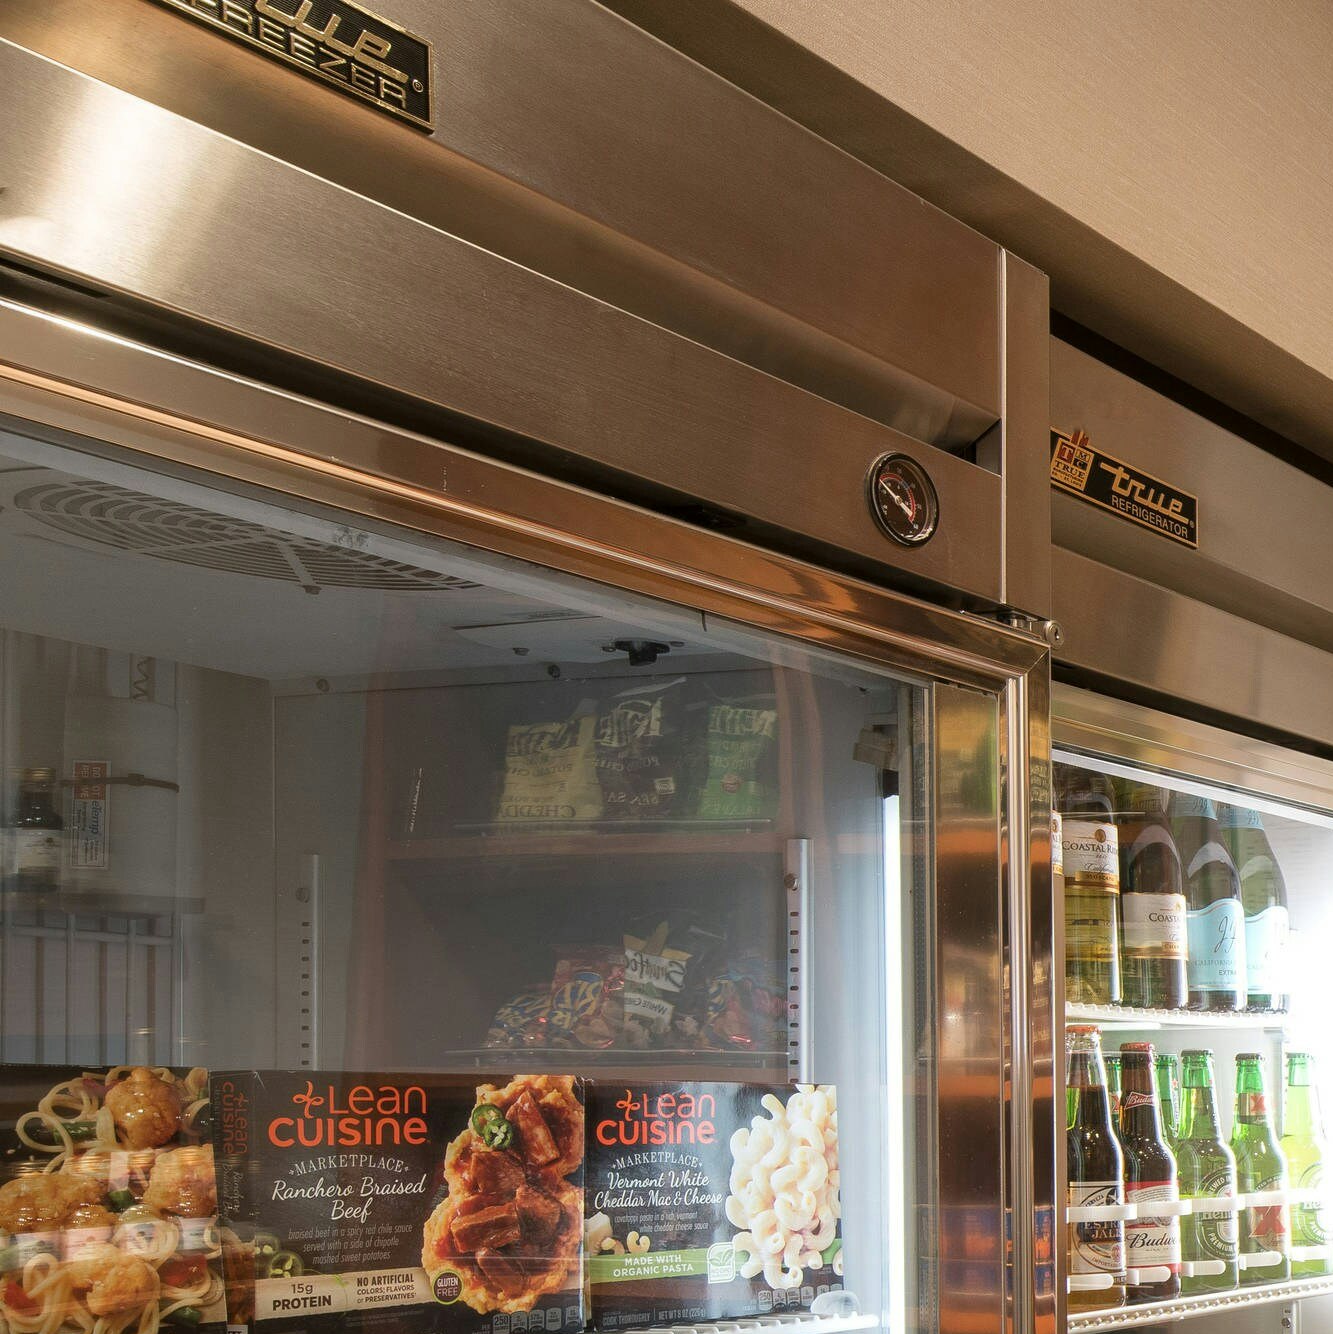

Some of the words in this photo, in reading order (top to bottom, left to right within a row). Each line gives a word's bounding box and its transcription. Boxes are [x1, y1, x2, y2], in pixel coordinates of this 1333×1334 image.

[1100, 463, 1188, 525] true
[1111, 495, 1188, 538] REFRIGERATOR
[329, 1085, 427, 1115] Lean
[643, 1092, 716, 1118] Lean
[295, 1155, 404, 1175] MARKETPLACE
[272, 1177, 354, 1201] Ranchero
[360, 1175, 426, 1197] Braised
[607, 1171, 665, 1190] Vermont
[668, 1170, 709, 1187] White
[595, 1190, 646, 1209] Cheddar
[648, 1190, 672, 1207] Mac
[674, 1195, 682, 1205] &
[684, 1188, 722, 1206] Cheese
[331, 1198, 372, 1224] Beef
[625, 1256, 653, 1266] MADE
[655, 1254, 682, 1264] WITH
[357, 1278, 369, 1287] NO
[371, 1273, 414, 1286] ARTIFICIAL
[613, 1265, 659, 1277] ORGANIC
[662, 1264, 694, 1273] PASTA
[291, 1283, 314, 1296] 15g
[436, 1276, 459, 1287] GLUTEN
[437, 1286, 459, 1297] FREE
[273, 1295, 332, 1311] PROTEIN
